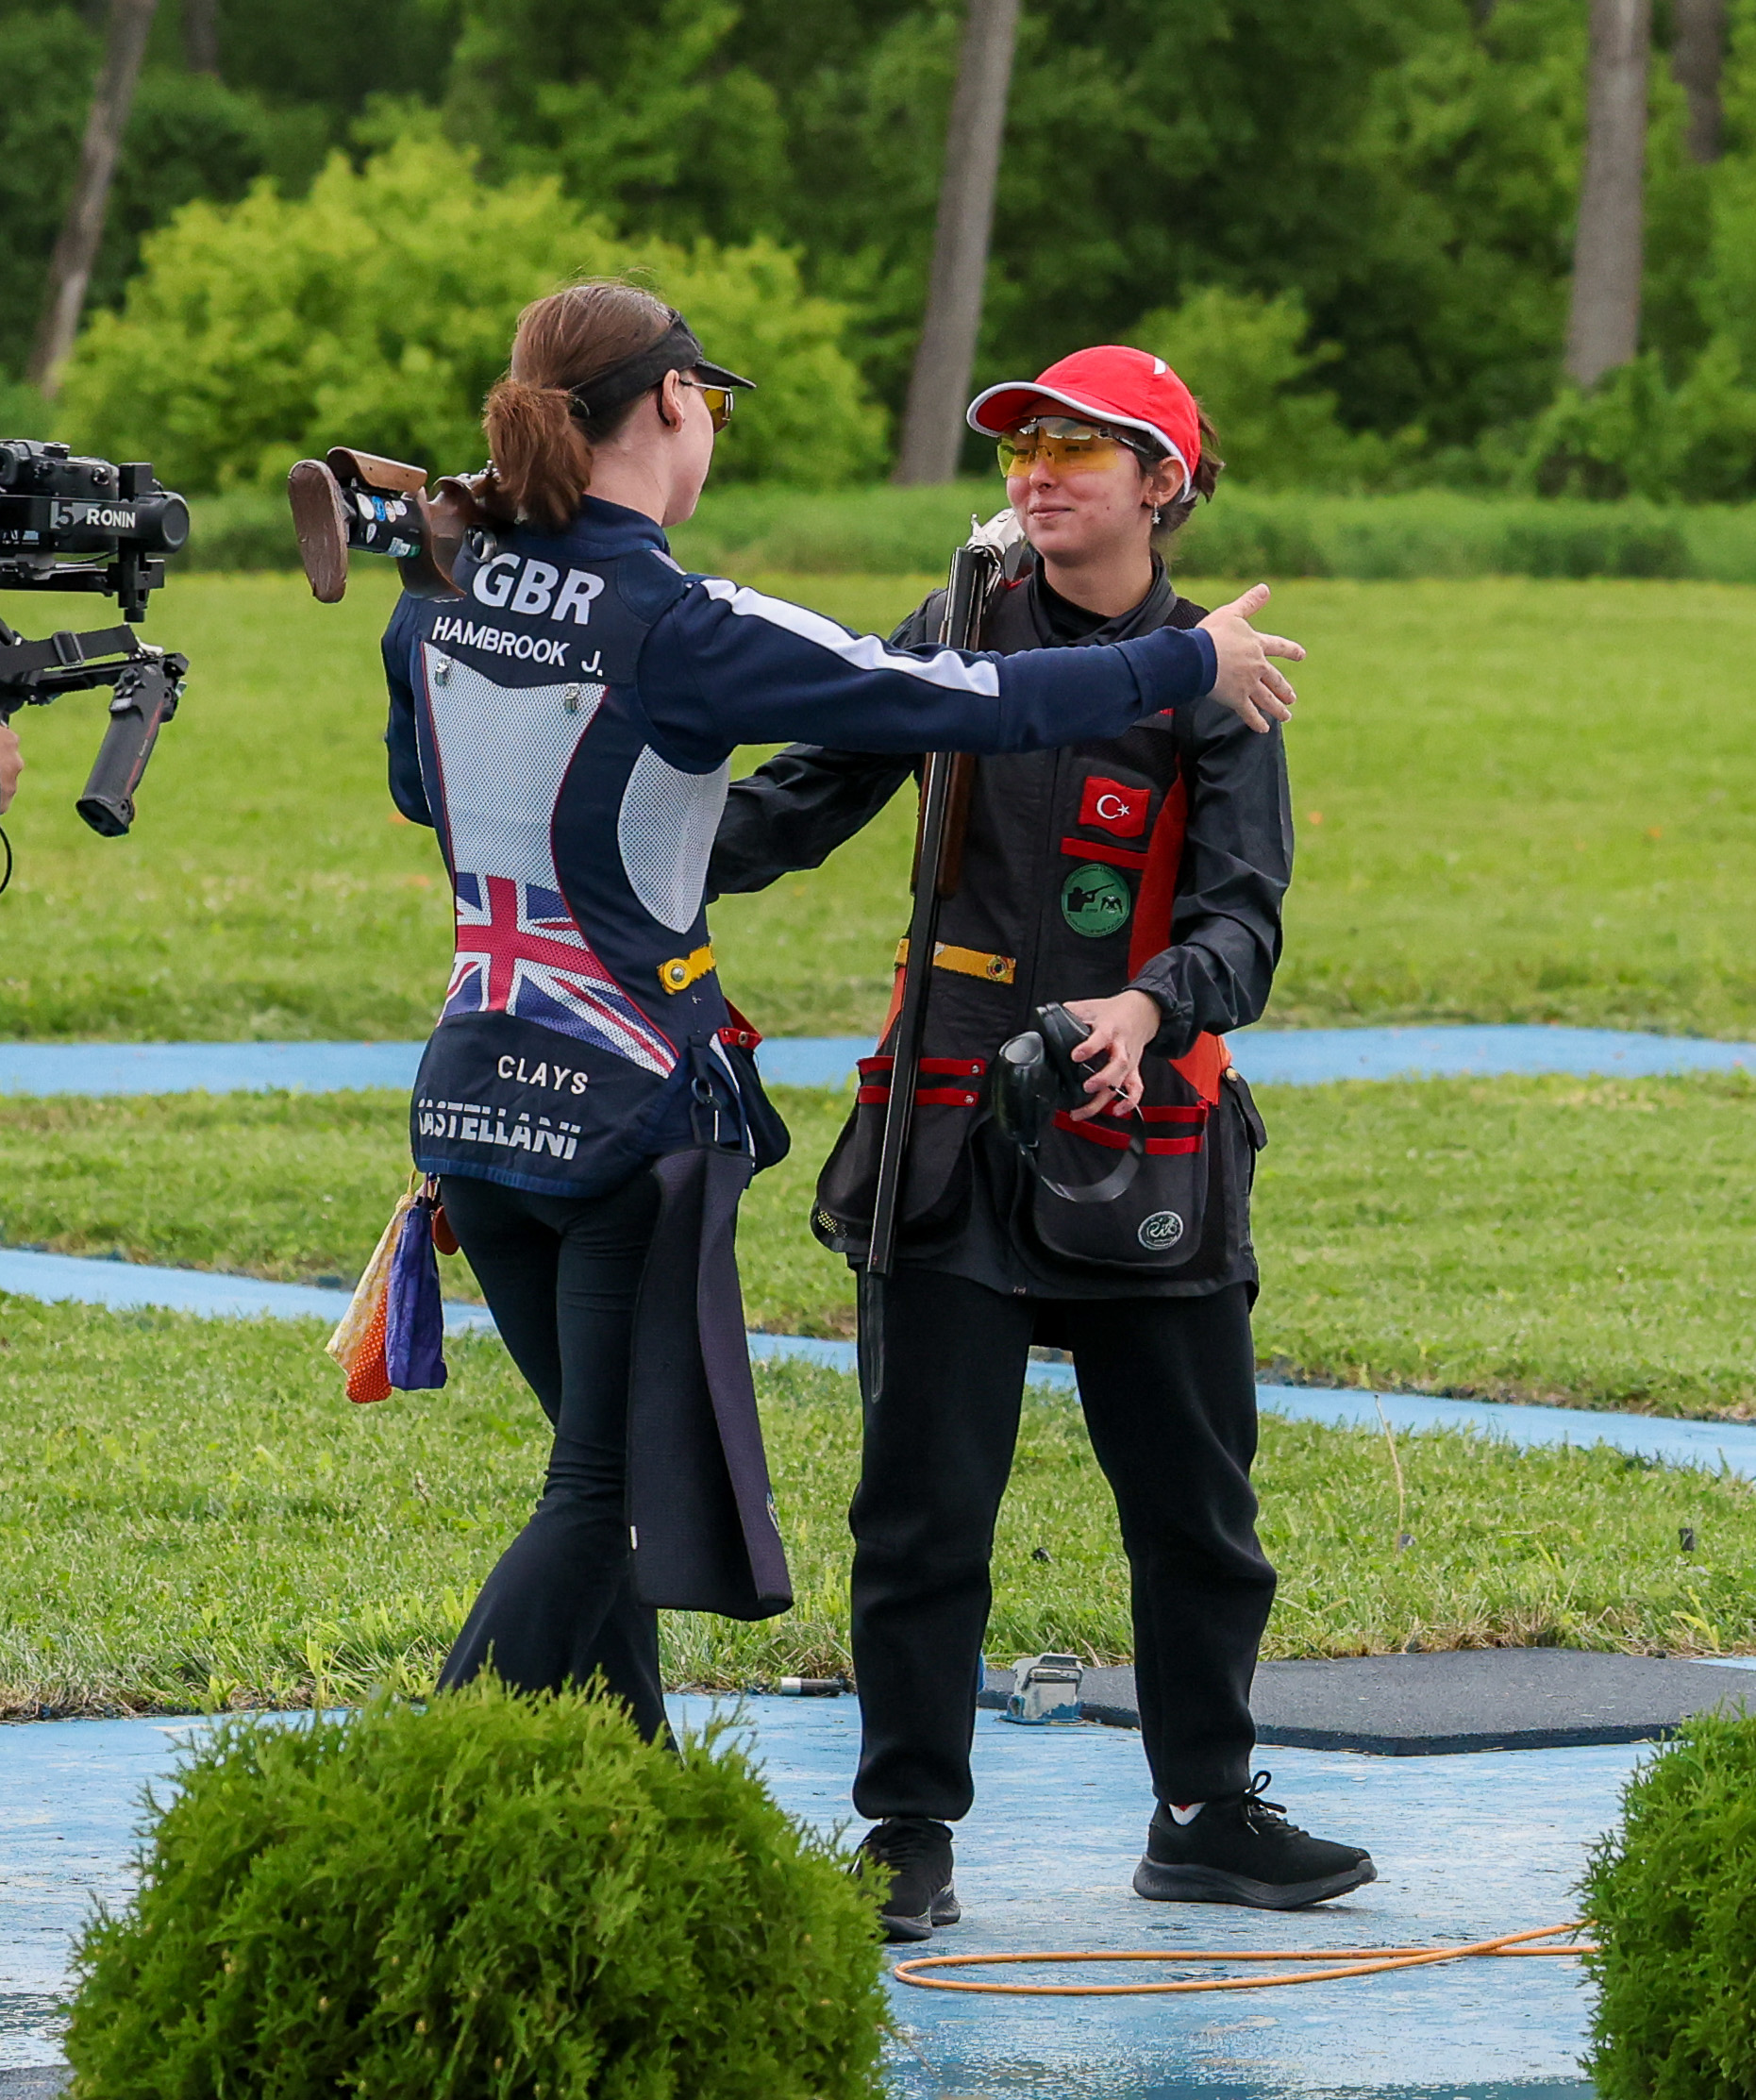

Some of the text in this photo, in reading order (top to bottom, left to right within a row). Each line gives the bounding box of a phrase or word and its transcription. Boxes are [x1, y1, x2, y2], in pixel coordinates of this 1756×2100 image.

[86, 508, 136, 529] RONIN
[473, 553, 605, 625] GBR
[431, 616, 603, 677] HAMBROOK J.
[498, 1055, 588, 1095] CLAYS
